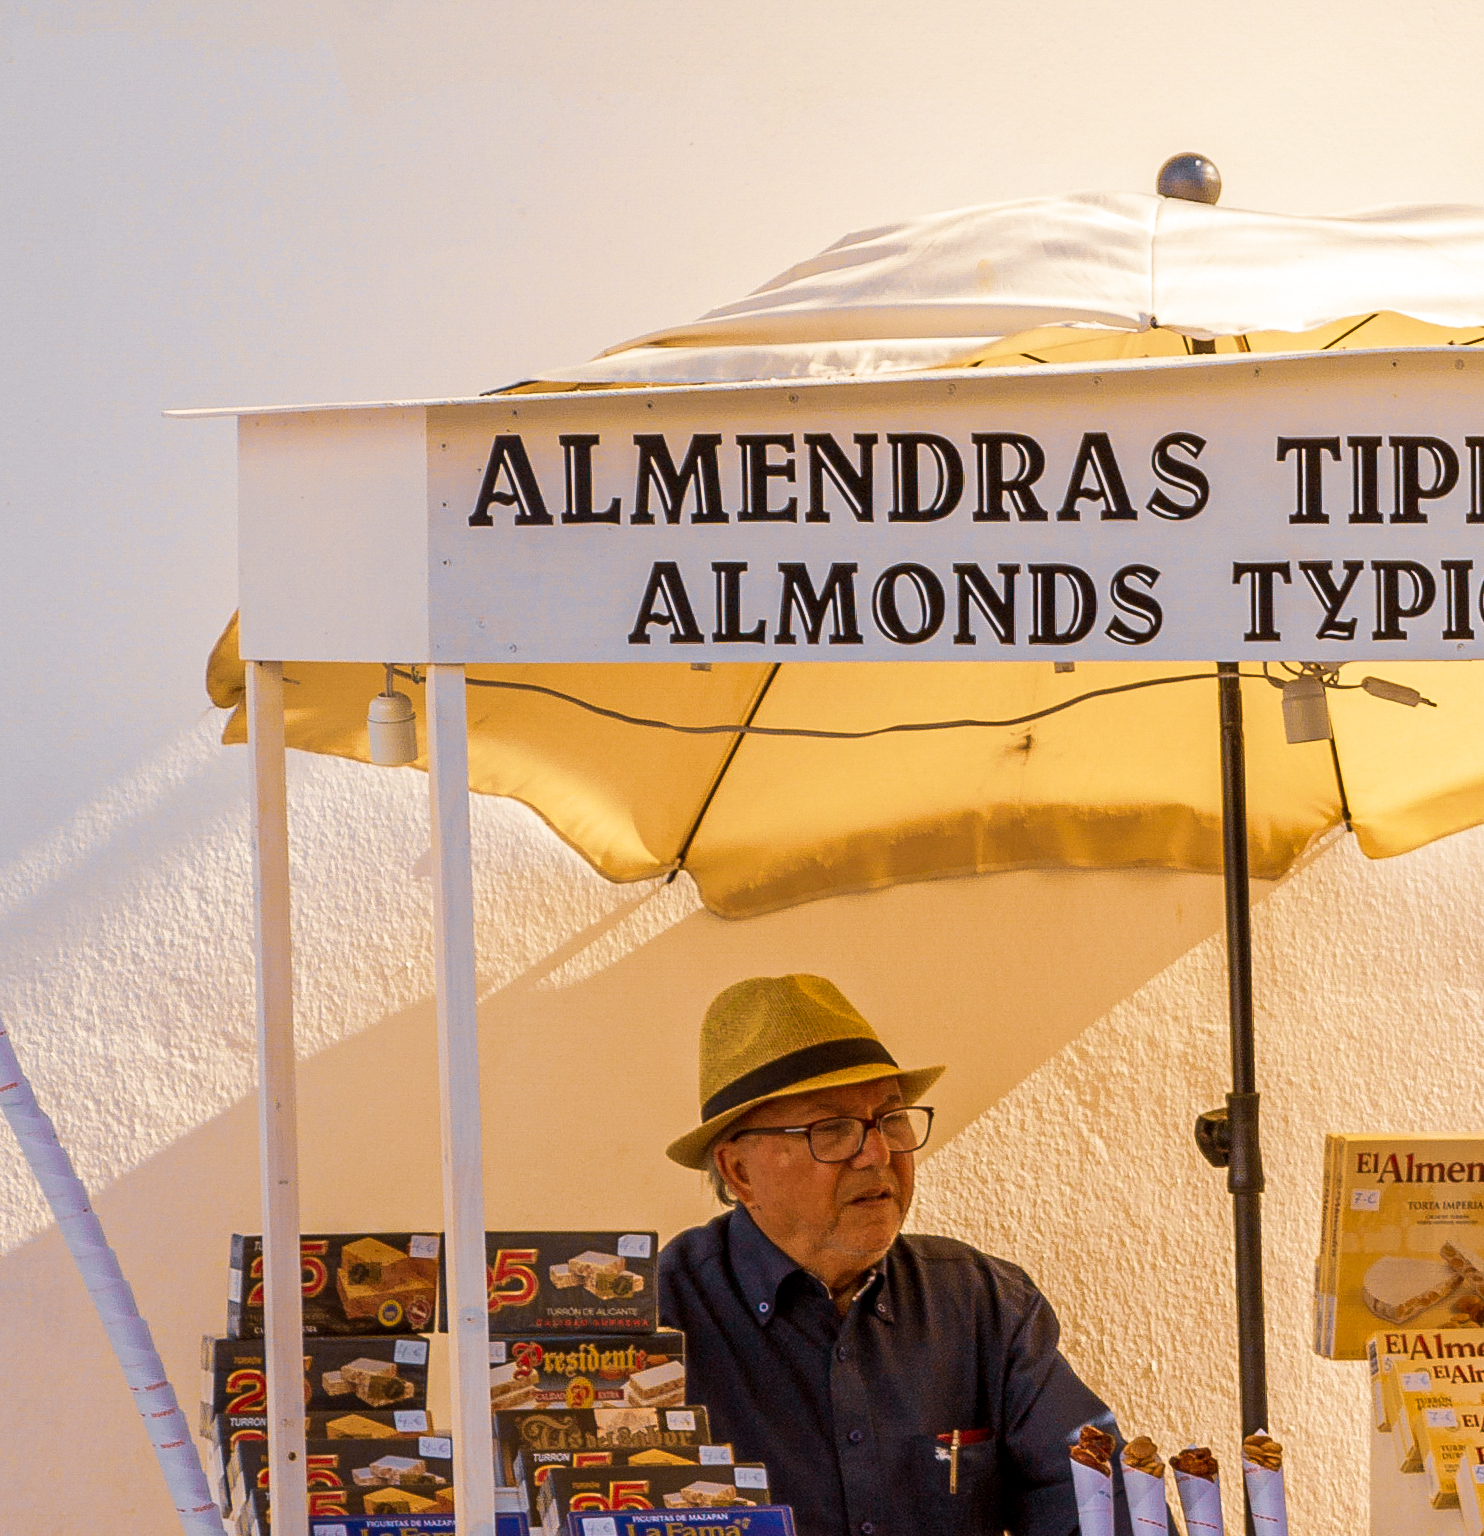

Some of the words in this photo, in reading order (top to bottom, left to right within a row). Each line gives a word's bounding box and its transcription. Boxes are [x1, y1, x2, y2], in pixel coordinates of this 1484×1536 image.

[468, 431, 1211, 527] ALMENDRAS
[627, 561, 1163, 647] ALMONDS
[1356, 1153, 1379, 1174] El
[512, 1341, 647, 1381] Presidente
[1462, 1415, 1479, 1428] El
[366, 1519, 408, 1527] FIGURITAS
[632, 1514, 674, 1523] FIGURITAS
[676, 1514, 686, 1522] DE
